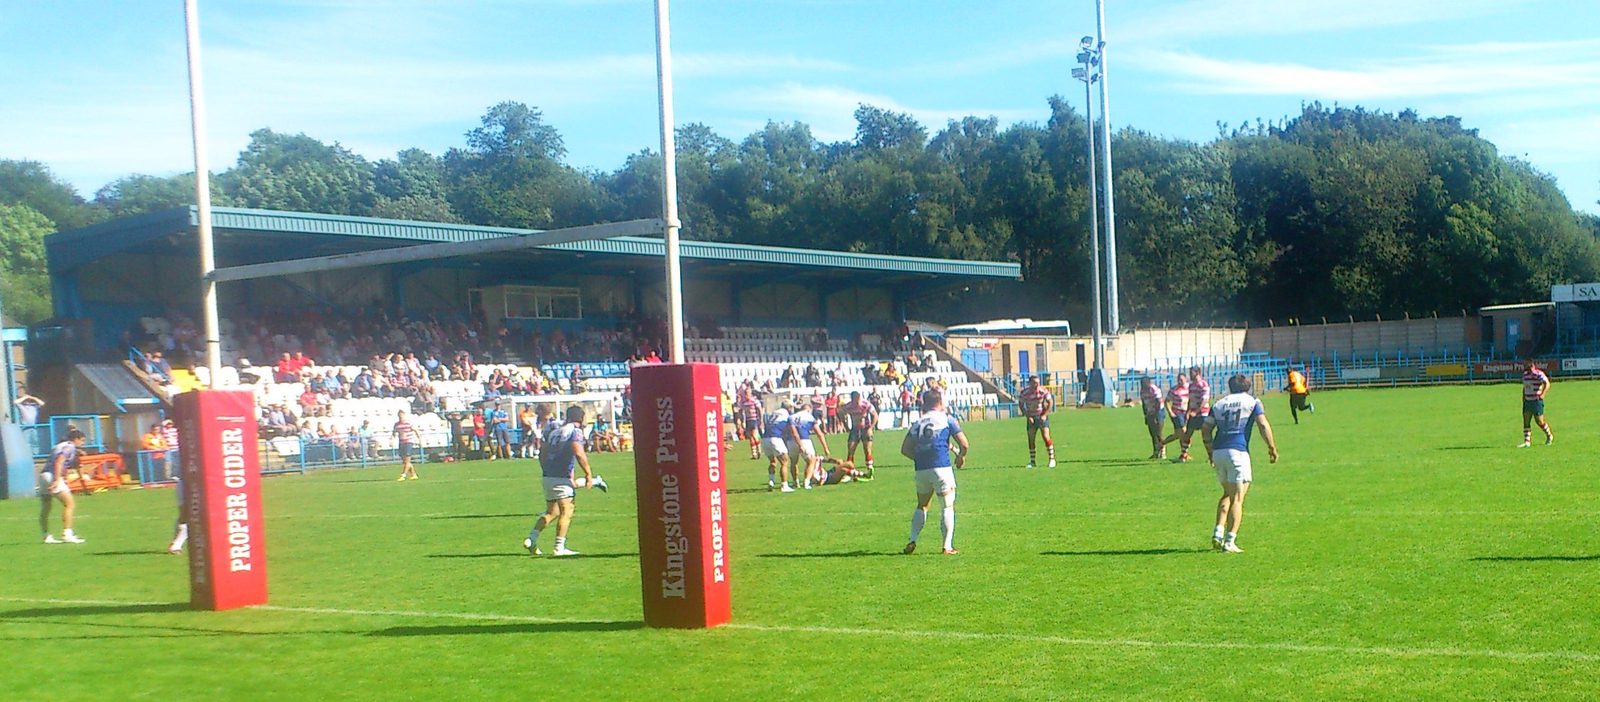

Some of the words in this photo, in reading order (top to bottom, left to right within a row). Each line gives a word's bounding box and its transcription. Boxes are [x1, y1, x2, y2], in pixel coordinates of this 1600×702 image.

[221, 427, 247, 489] CIDER
[656, 396, 679, 463] Press
[706, 410, 720, 482] CIDER
[227, 492, 251, 572] PROPER
[660, 473, 688, 598] Kingstone
[711, 488, 724, 583] PROPER
